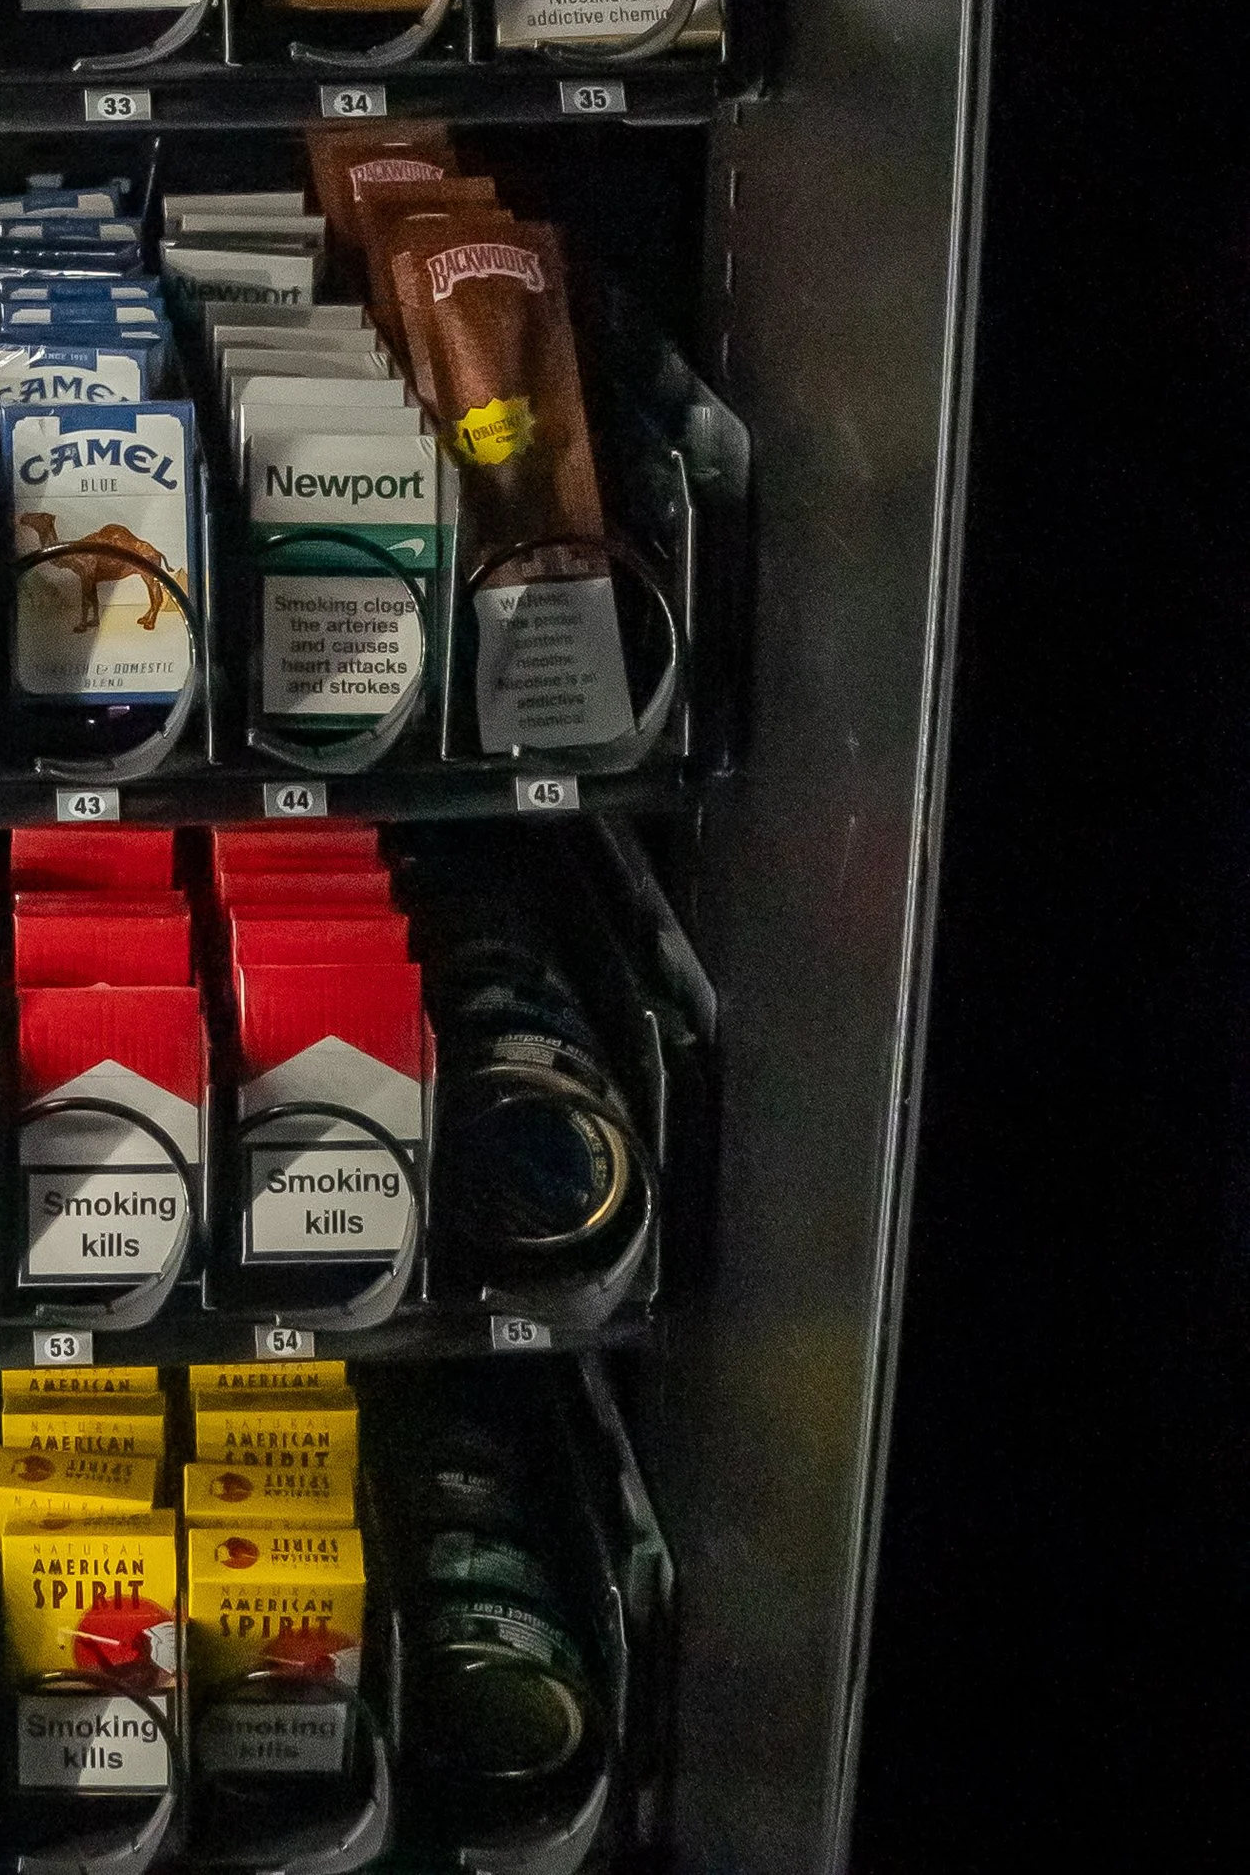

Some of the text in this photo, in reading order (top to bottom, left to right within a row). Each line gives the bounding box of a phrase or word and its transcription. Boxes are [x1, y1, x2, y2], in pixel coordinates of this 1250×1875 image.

[527, 11, 603, 27] addictive
[102, 94, 132, 116] 33
[339, 92, 369, 114] 34
[579, 87, 608, 109] 35
[20, 438, 178, 490] CAMEL
[81, 478, 118, 493] BLUE
[265, 465, 424, 505] Newport
[275, 596, 416, 614] Smoking clogs
[290, 618, 399, 633] the arteries
[290, 640, 399, 654] and causes
[282, 659, 408, 674] heart attacks
[289, 679, 401, 694] and strokes
[283, 790, 310, 810] 44
[534, 783, 560, 804] 45
[75, 795, 102, 816] 43
[266, 1168, 400, 1197] Smoking
[44, 1192, 177, 1222] Smoking
[305, 1209, 364, 1234] kills
[81, 1232, 140, 1257] kills
[271, 1331, 298, 1352] 54
[505, 1321, 533, 1343] 55
[49, 1337, 76, 1357] 53
[29, 1378, 130, 1393] AMERICAN
[217, 1373, 319, 1389] AMERICAN
[29, 1436, 136, 1452] AMERICAN
[225, 1431, 330, 1448] AMERICAN
[33, 1543, 145, 1555] NATURAL
[32, 1558, 145, 1576] AMERICAN
[33, 1579, 145, 1610] SPIRIT
[220, 1599, 334, 1612] AMERICAN
[220, 1615, 332, 1638] SPIRIT
[26, 1715, 159, 1742] Smoking
[62, 1746, 124, 1770] kills
